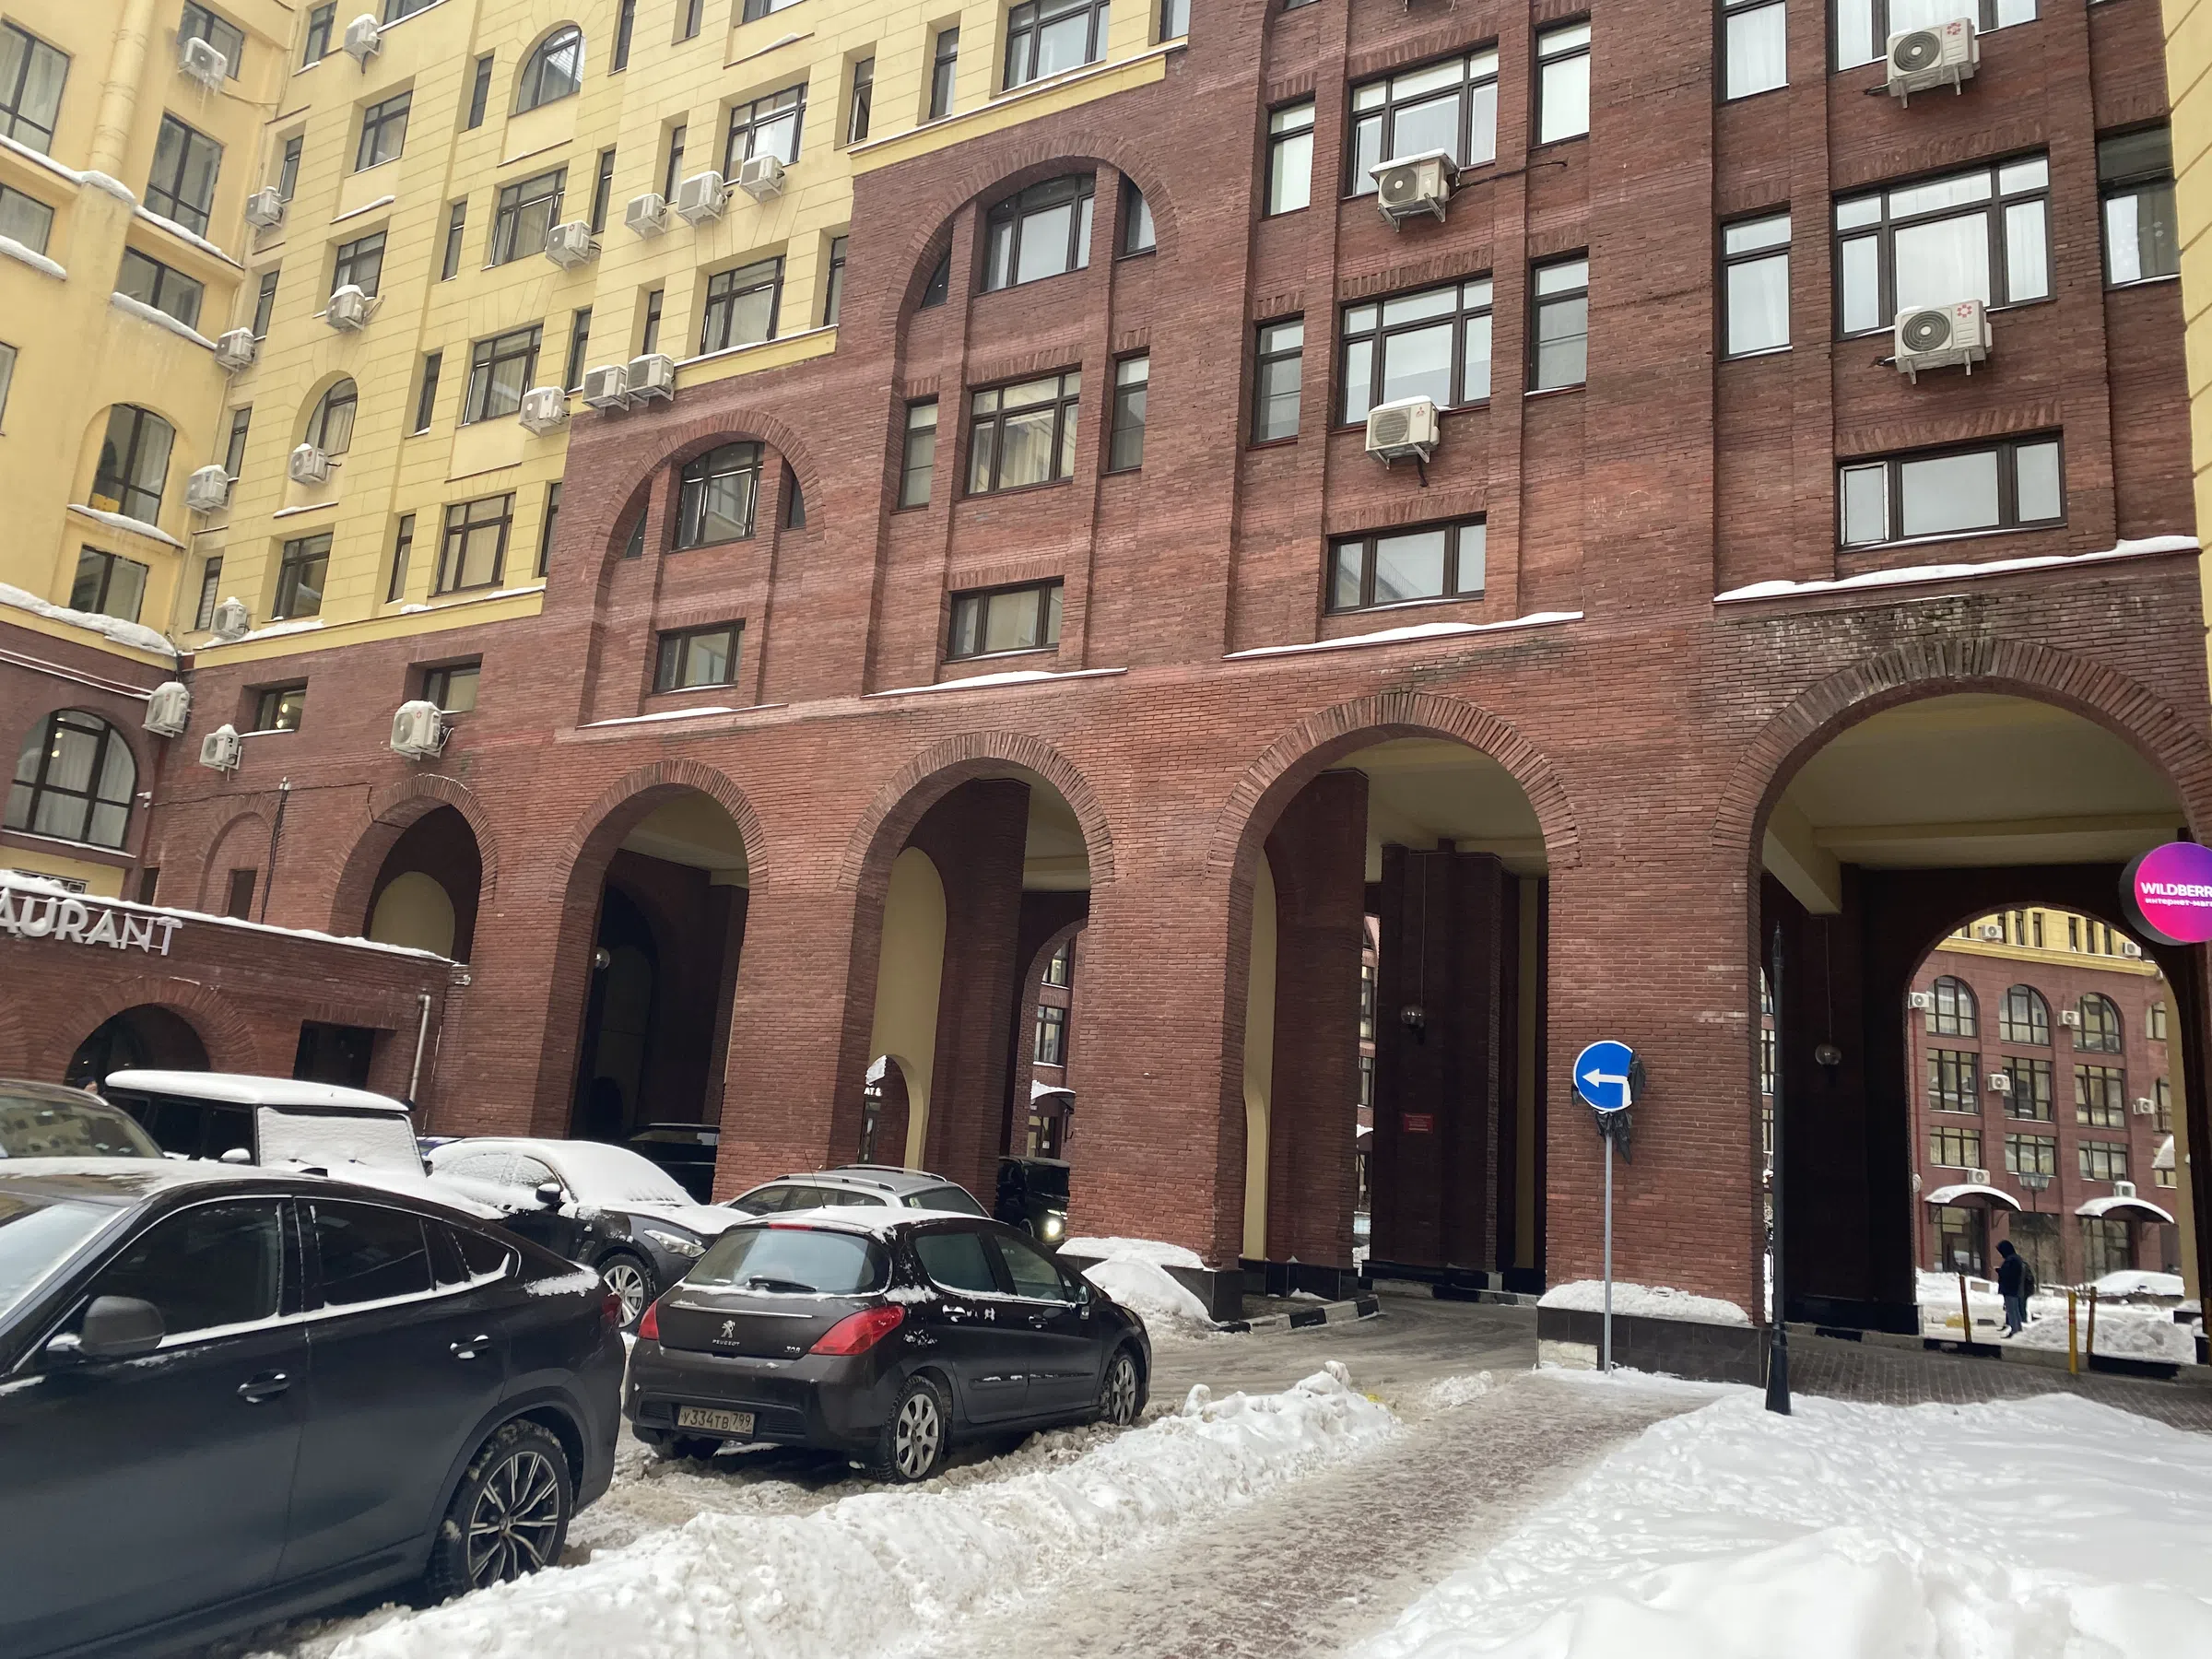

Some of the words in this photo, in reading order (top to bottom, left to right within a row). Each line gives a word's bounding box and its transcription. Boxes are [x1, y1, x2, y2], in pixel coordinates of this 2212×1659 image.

[2140, 881, 2212, 898] WILDBERR
[0, 888, 183, 956] AURANT
[784, 1346, 801, 1354] 308
